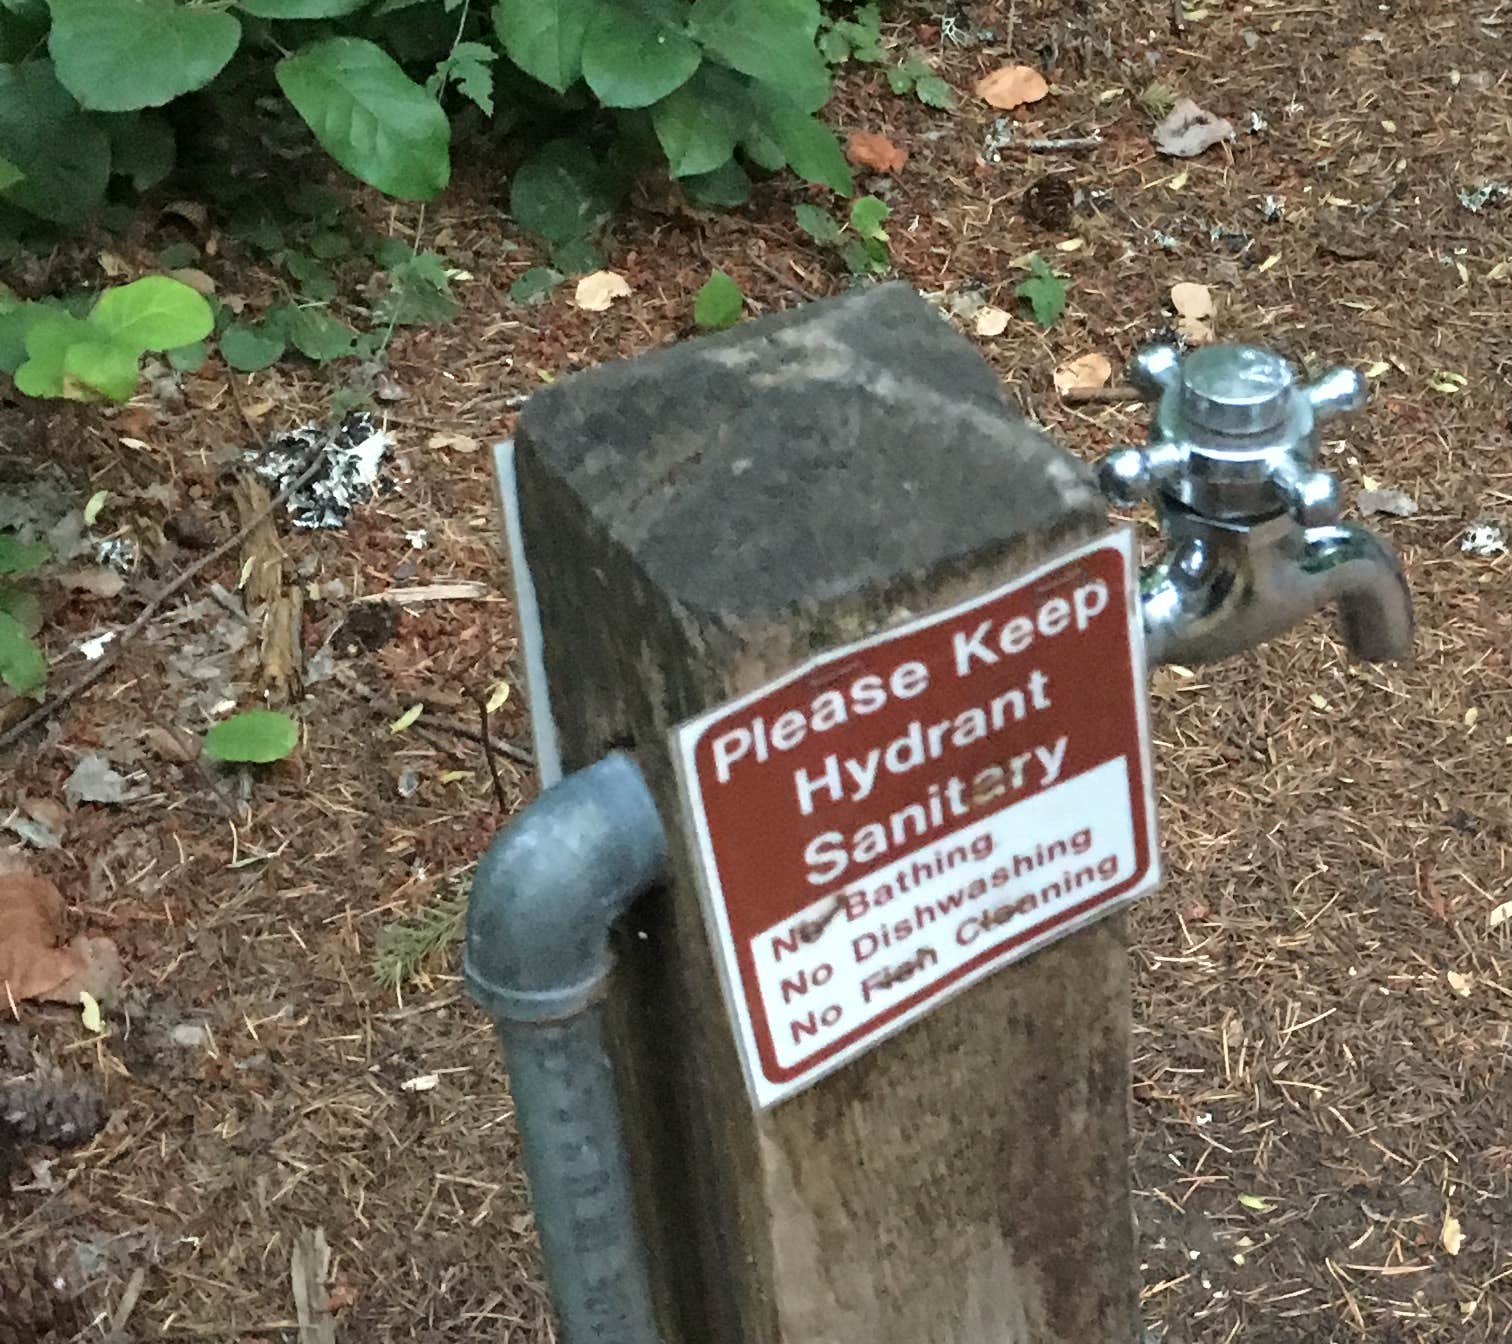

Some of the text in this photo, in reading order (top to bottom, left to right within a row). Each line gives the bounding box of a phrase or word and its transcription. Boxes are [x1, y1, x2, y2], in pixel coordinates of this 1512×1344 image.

[711, 578, 1109, 783] Please Keep
[794, 669, 1052, 816] Hydrant
[804, 736, 1069, 885] Sanitary
[844, 834, 993, 921] Bathing
[781, 827, 1092, 1005] No Dishwashing
[790, 1005, 843, 1045] No
[956, 854, 1119, 946] Cleaning
